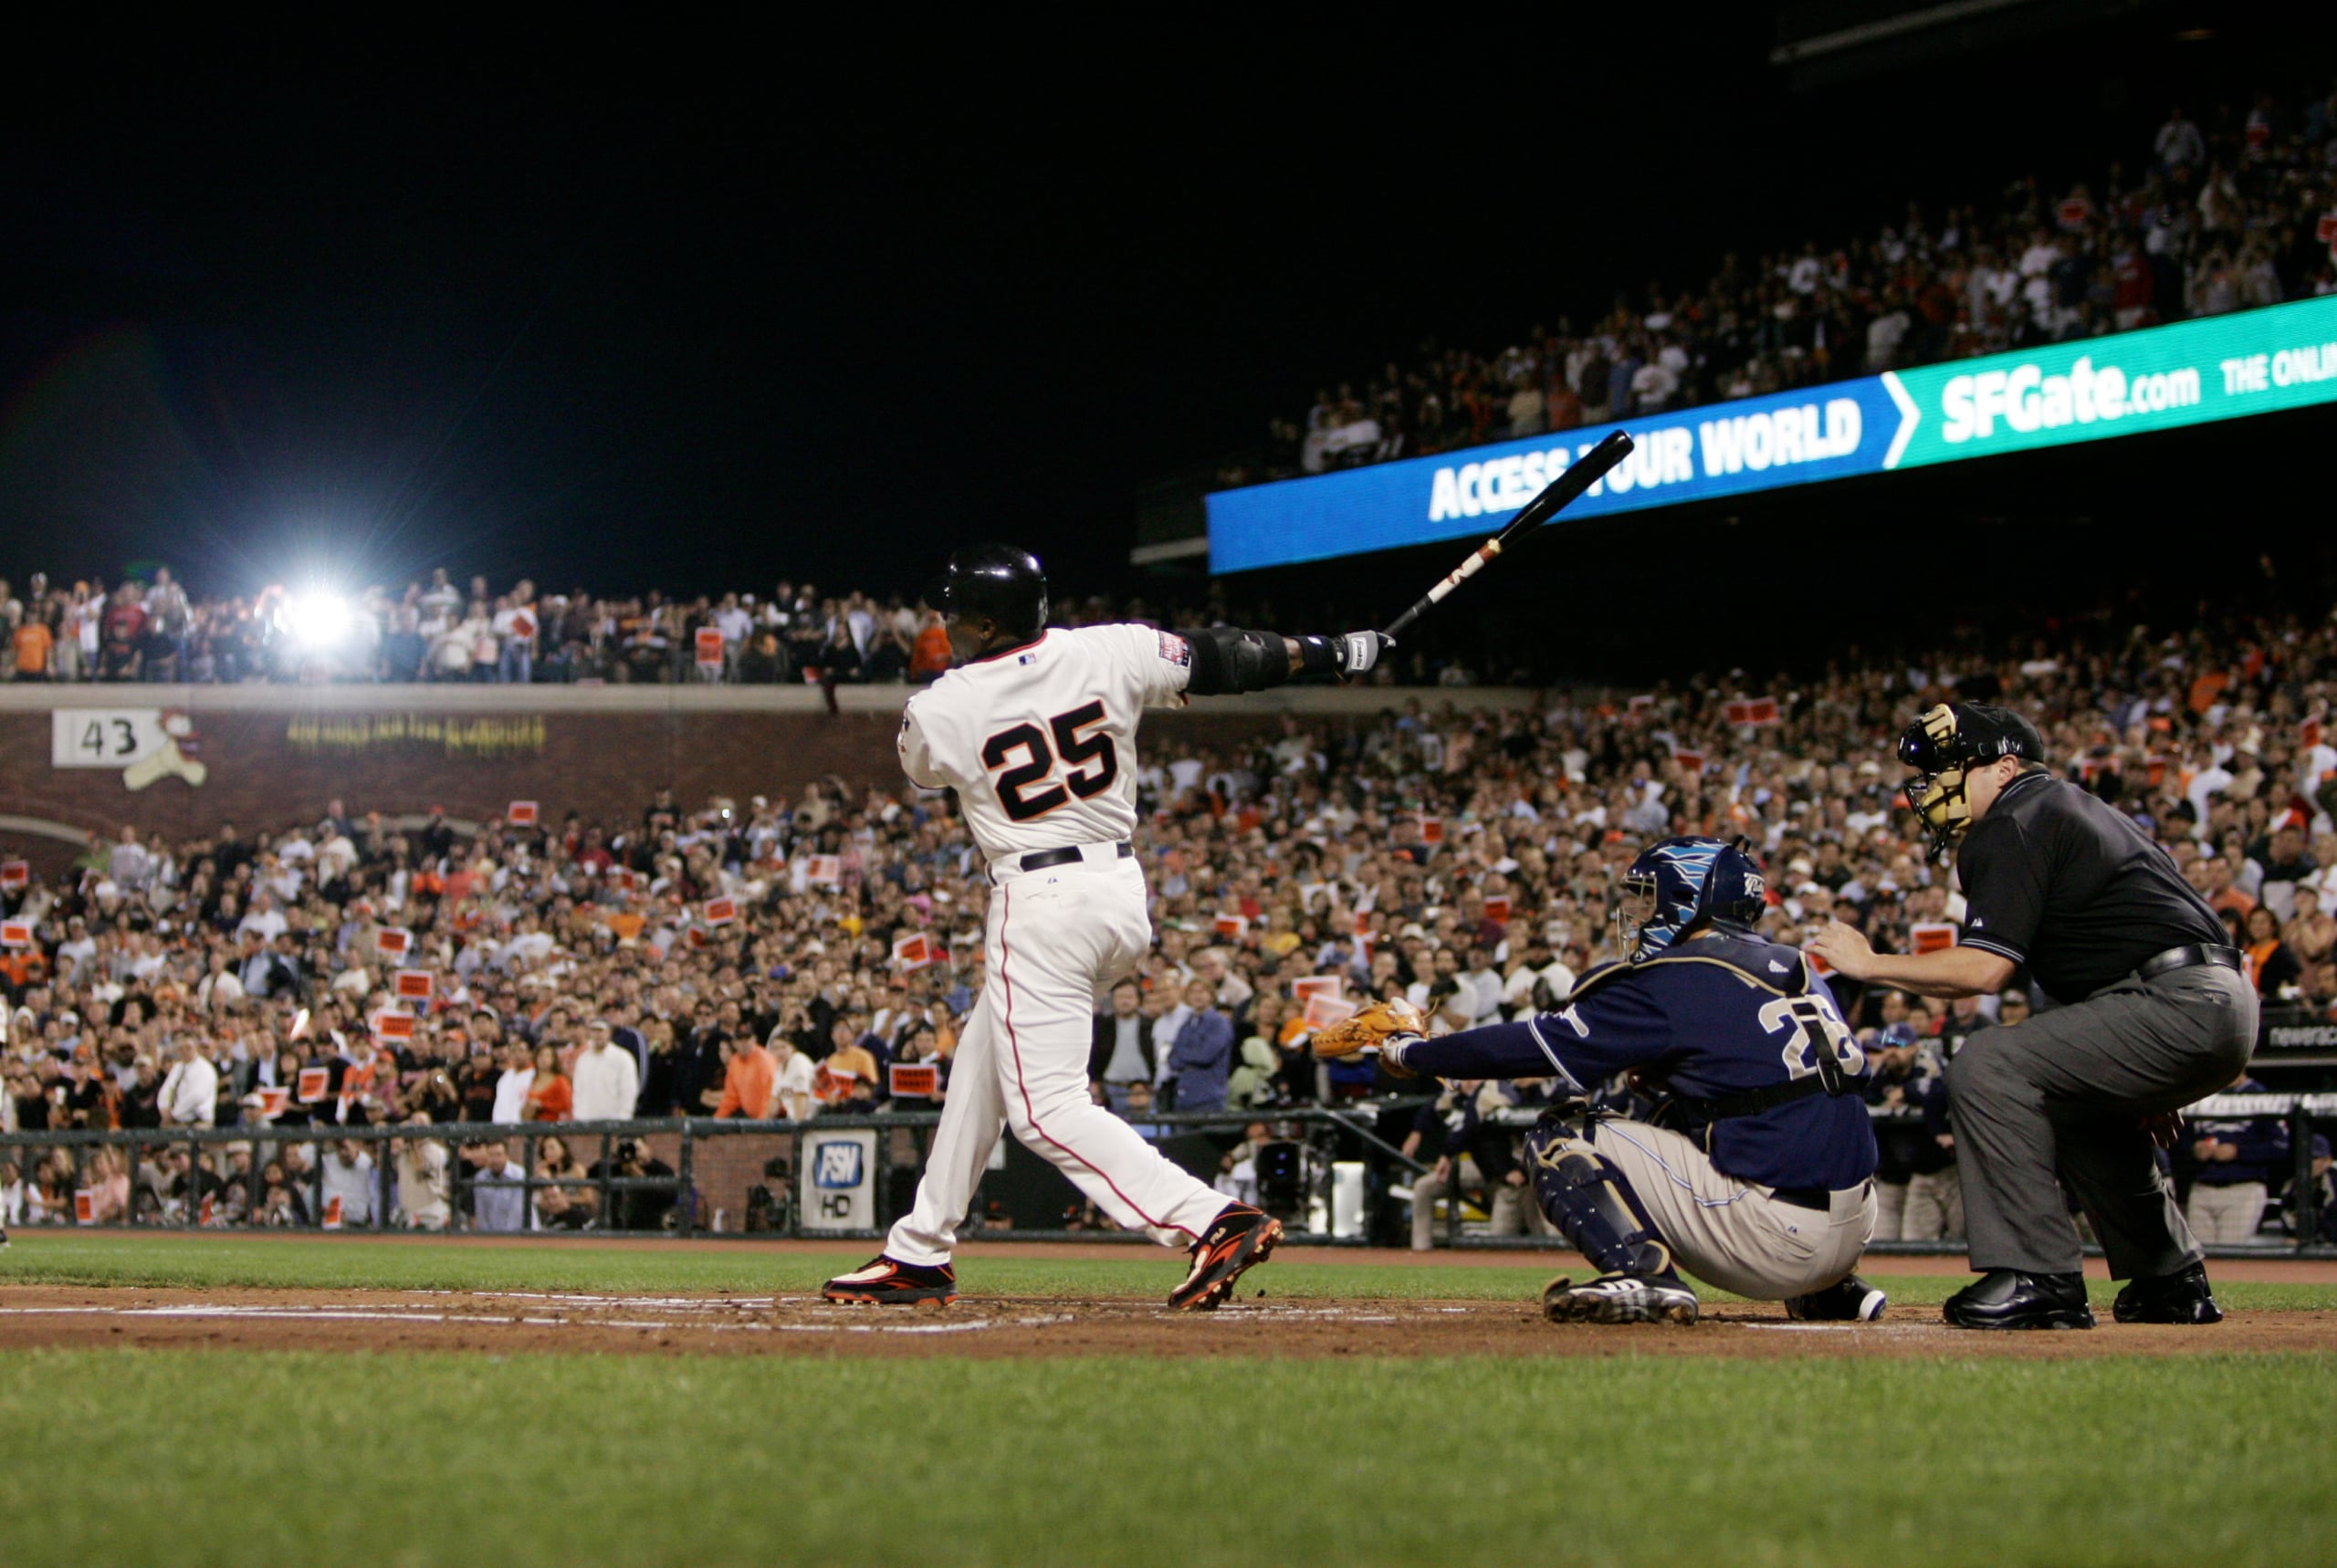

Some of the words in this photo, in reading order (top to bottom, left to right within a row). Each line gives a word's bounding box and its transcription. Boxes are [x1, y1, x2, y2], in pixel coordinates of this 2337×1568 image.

[1699, 400, 1862, 477] WORLD
[1942, 355, 2201, 444] SFGate.com
[2220, 354, 2269, 395] THE
[80, 718, 137, 757] 43
[981, 699, 1117, 822] 25
[823, 1195, 850, 1218] HD
